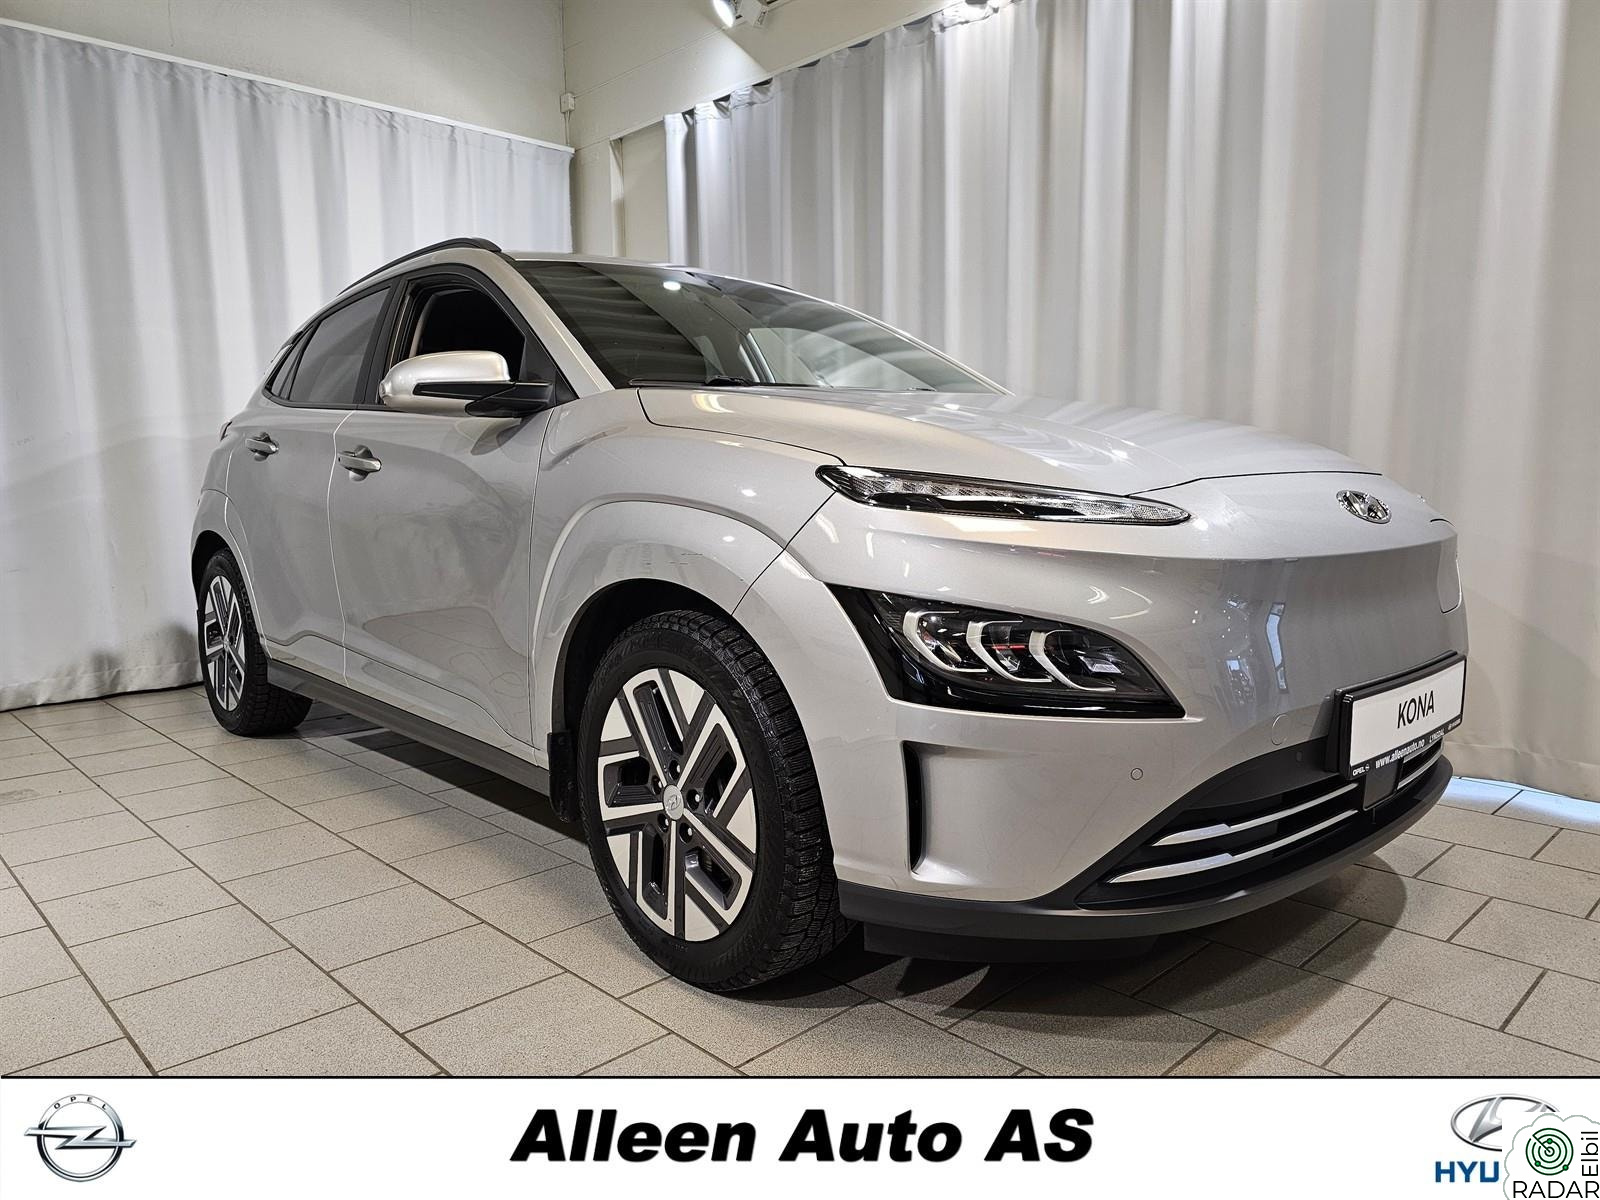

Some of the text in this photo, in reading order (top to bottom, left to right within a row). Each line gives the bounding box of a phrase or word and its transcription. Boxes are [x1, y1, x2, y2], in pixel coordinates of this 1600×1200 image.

[1397, 690, 1435, 729] KONA
[1352, 767, 1366, 776] OPEL
[1375, 739, 1424, 769] www.alleenauto.no
